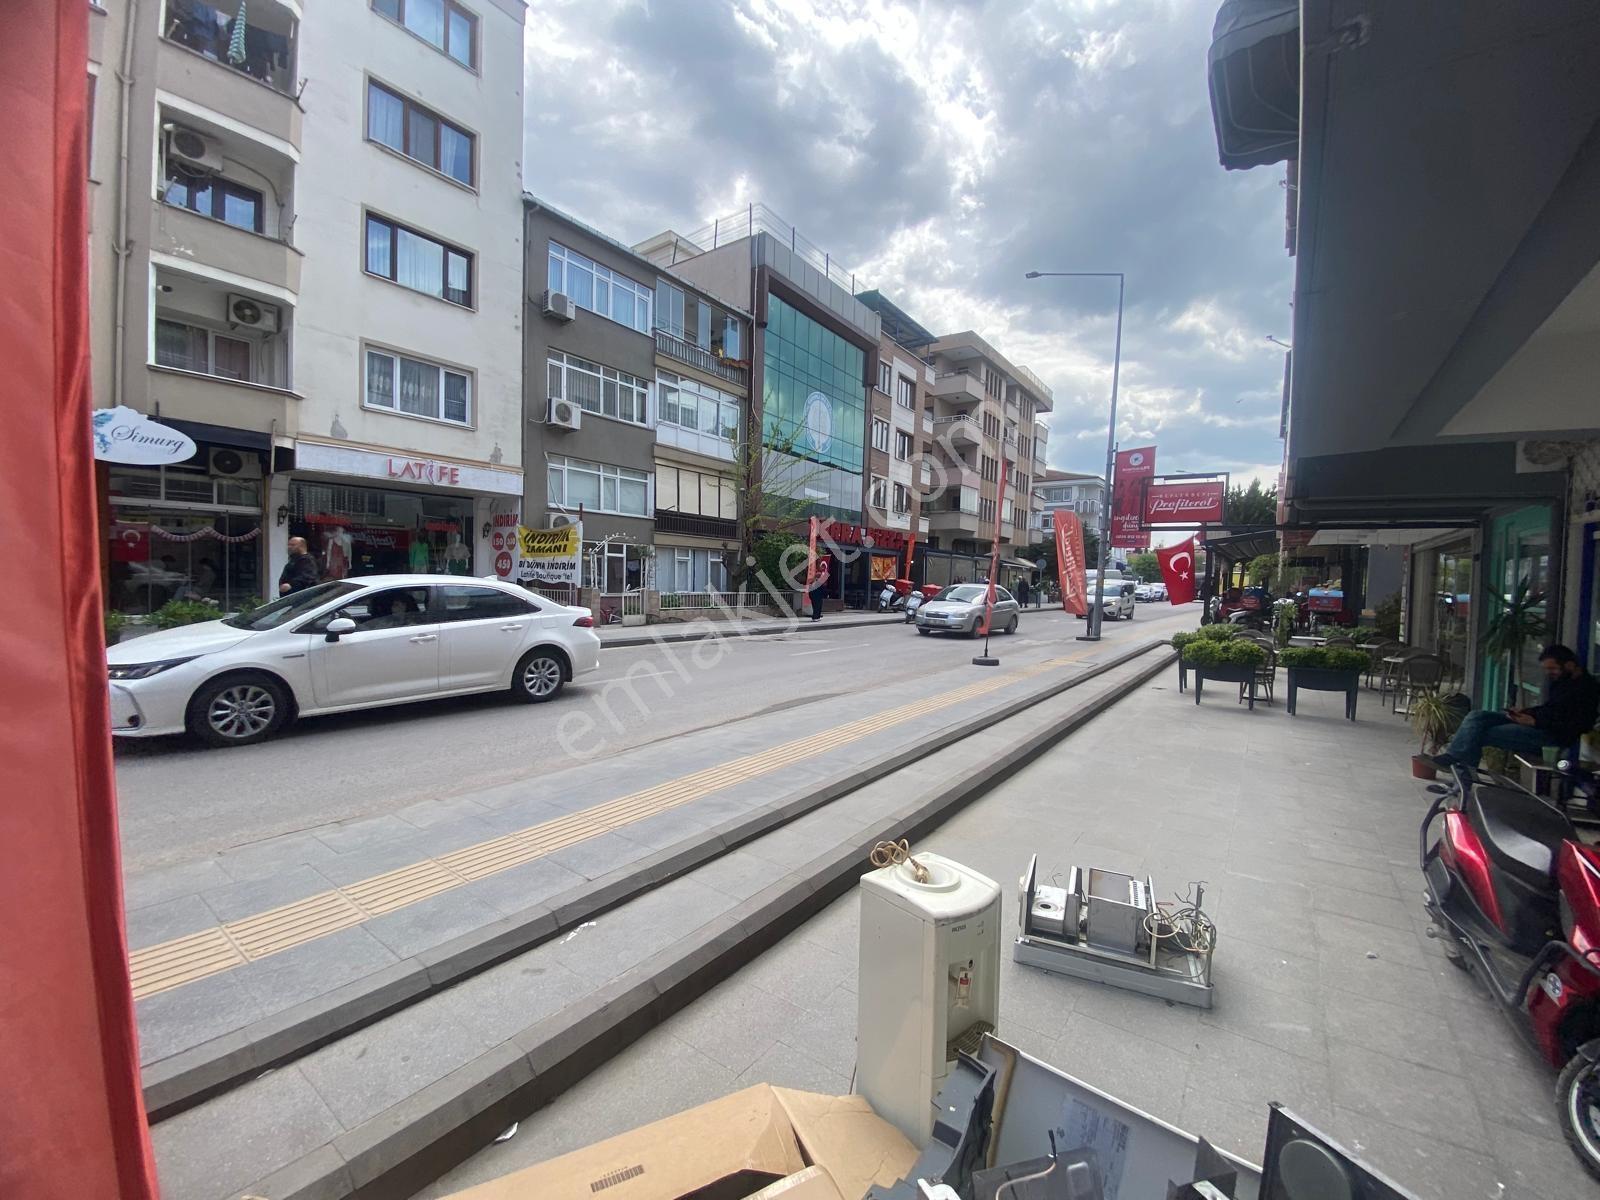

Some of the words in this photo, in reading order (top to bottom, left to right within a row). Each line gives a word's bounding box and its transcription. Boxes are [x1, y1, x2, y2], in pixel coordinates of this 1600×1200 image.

[111, 425, 184, 455] Simurg
[1149, 497, 1218, 515] Profiterol
[526, 544, 568, 554] ZAMANI
